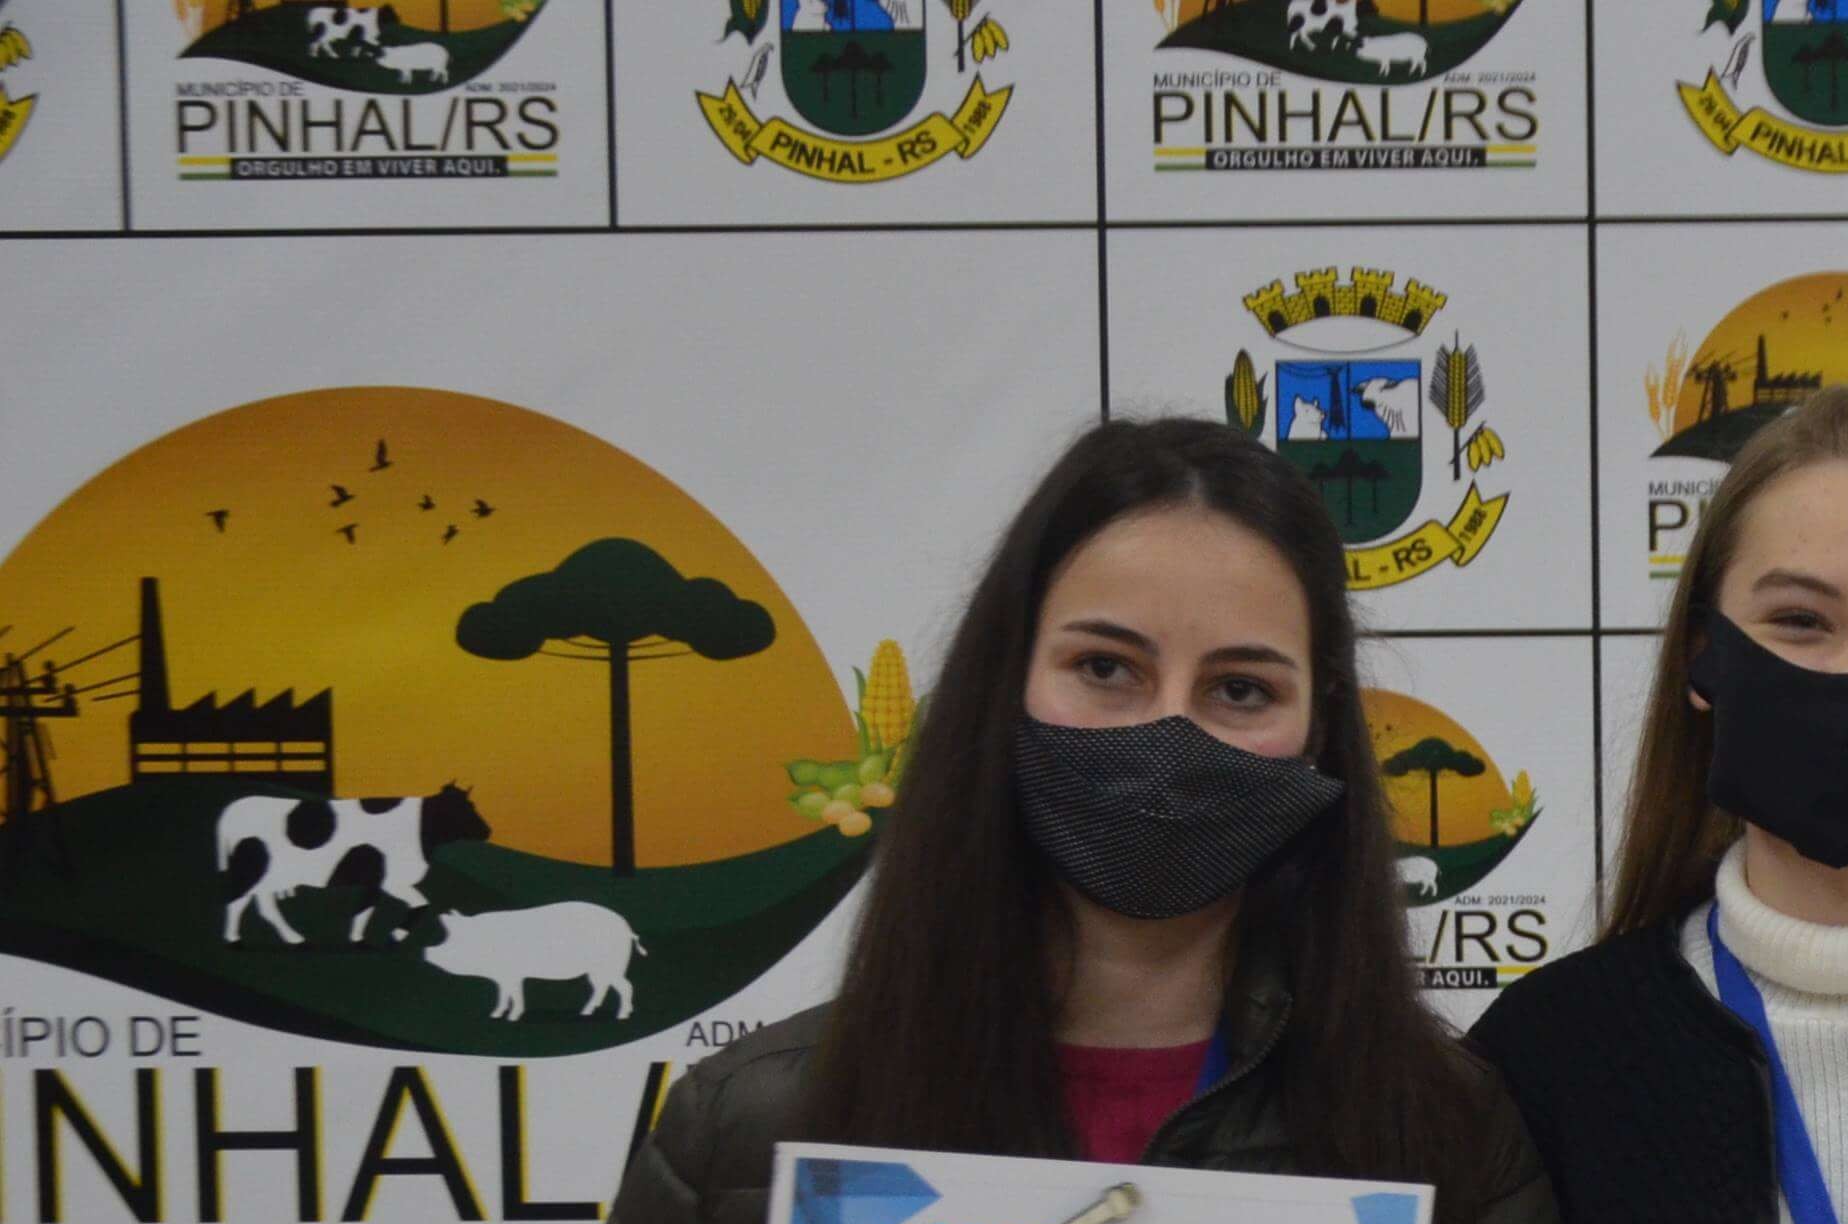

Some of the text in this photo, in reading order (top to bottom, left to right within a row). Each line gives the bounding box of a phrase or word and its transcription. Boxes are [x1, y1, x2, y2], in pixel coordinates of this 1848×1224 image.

[280, 81, 304, 96] DE
[1154, 68, 1282, 88] MUNICÍPIO DE
[176, 97, 560, 153] PINHAL/RS
[1153, 88, 1538, 144] PINHAL/RS
[238, 160, 336, 176] ORGULHO
[343, 159, 372, 175] EM
[378, 159, 438, 175] VIVER
[771, 131, 875, 175] PINHAL
[899, 131, 938, 166] RS
[1213, 150, 1314, 169] ORGULHO
[1320, 150, 1349, 167] EM
[1355, 150, 1414, 167] VIVER
[1393, 537, 1434, 572] RS
[1432, 970, 1490, 987] AQUI.
[3, 1006, 204, 1058] ÍPIO DE
[32, 1061, 673, 1224] NHAL/
